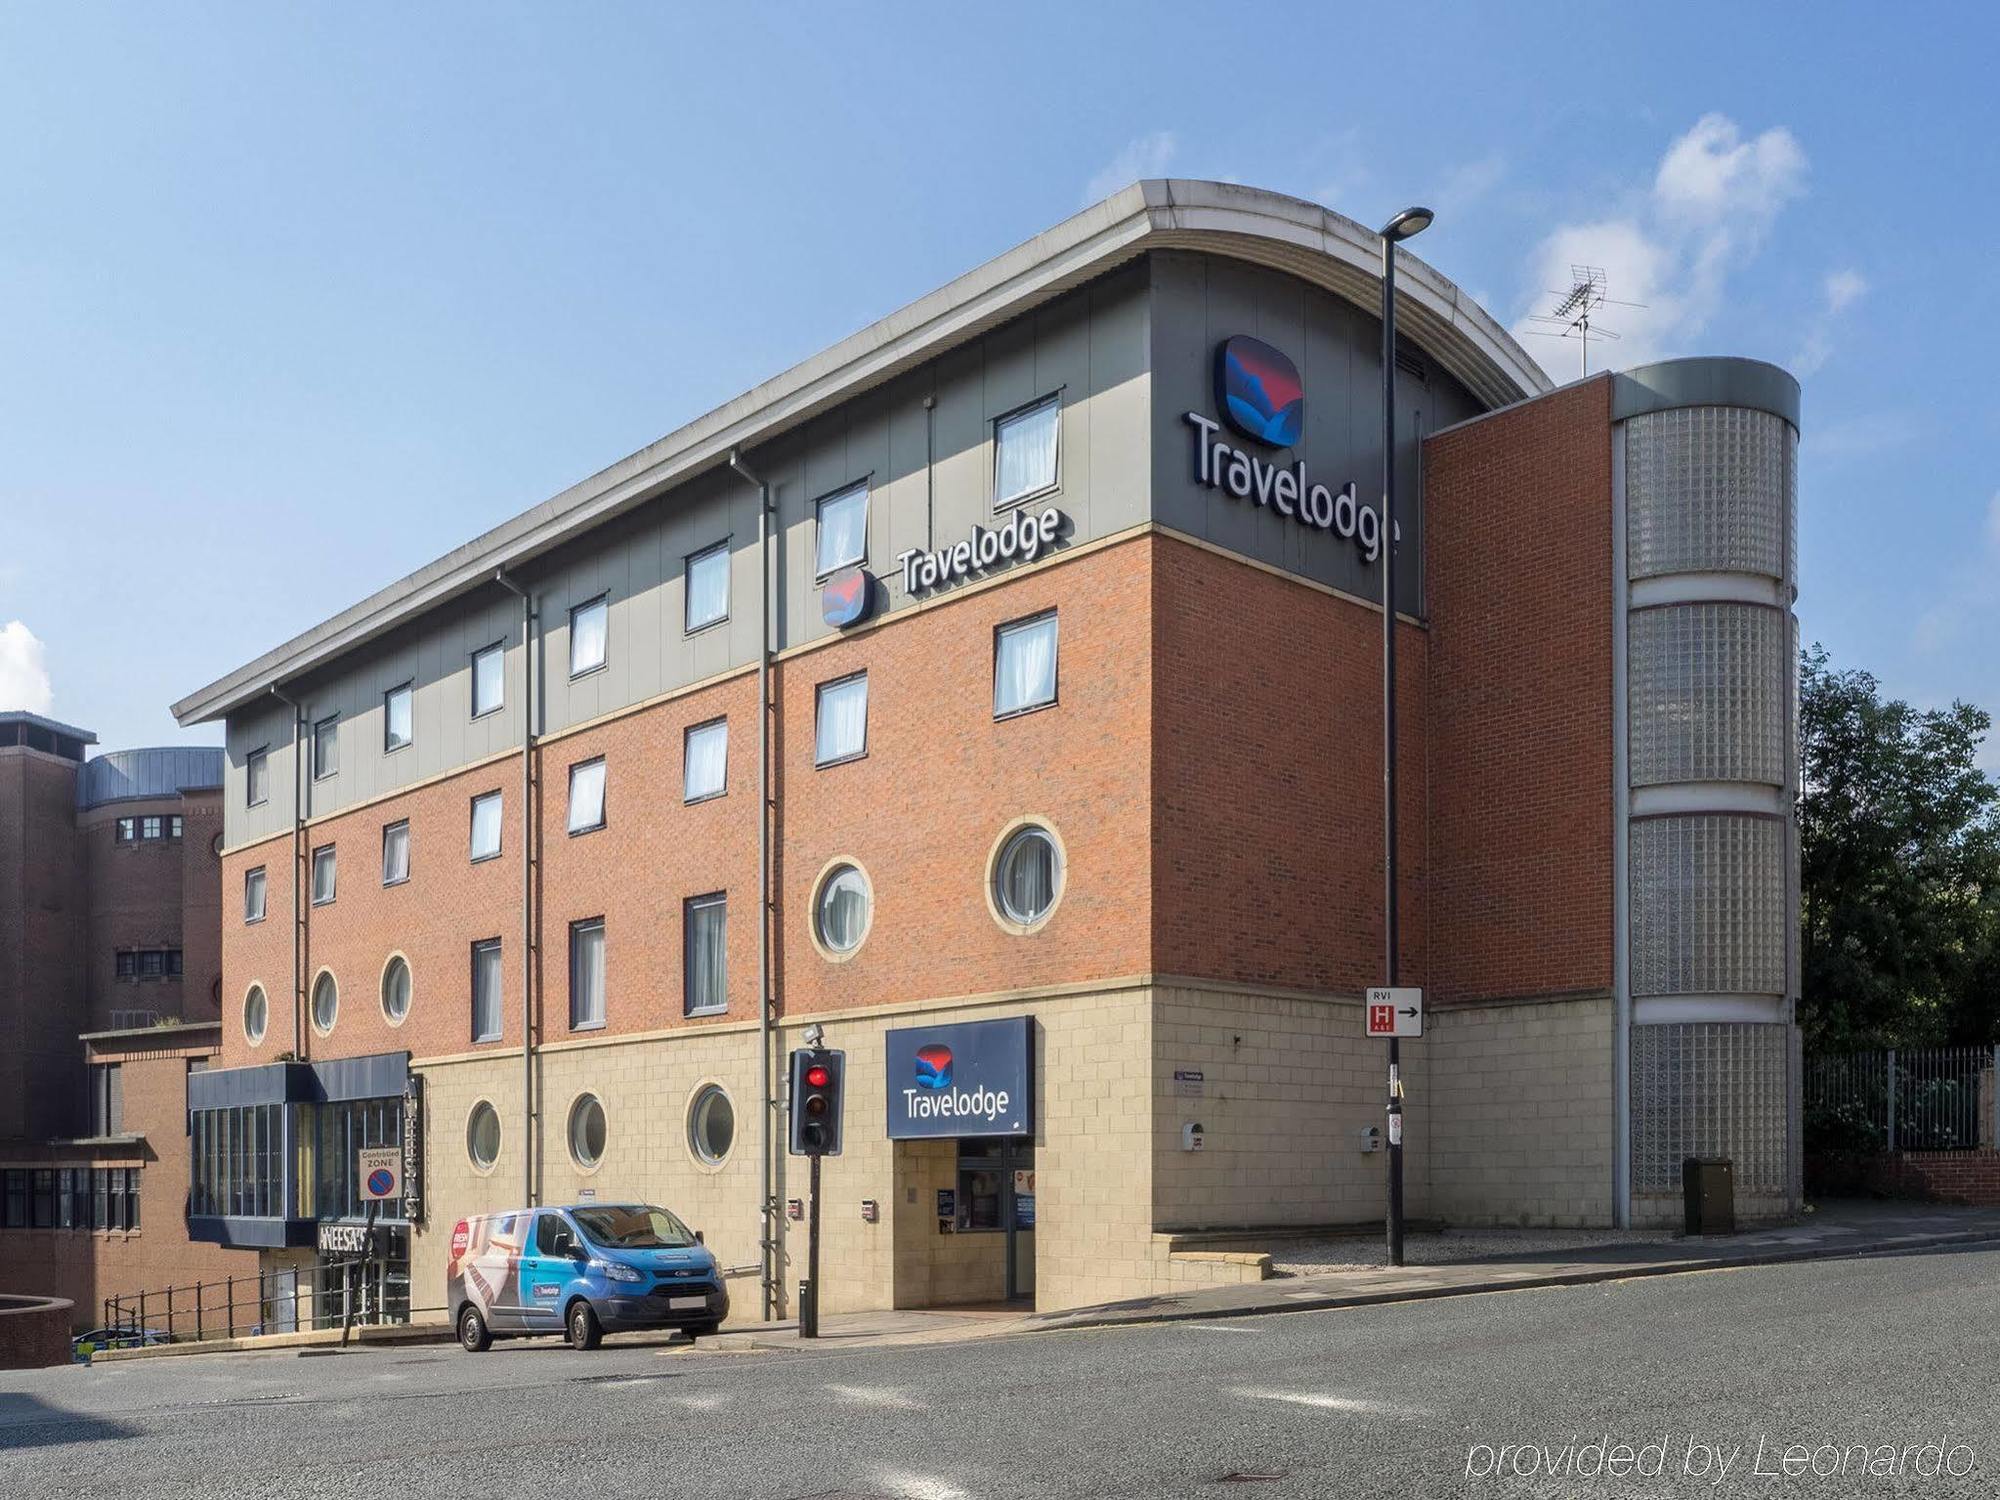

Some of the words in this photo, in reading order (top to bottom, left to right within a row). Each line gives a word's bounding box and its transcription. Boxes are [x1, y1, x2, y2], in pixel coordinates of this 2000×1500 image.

[897, 507, 1060, 593] Travelodge
[1373, 991, 1391, 1000] RVI
[1376, 1006, 1389, 1024] H
[903, 1084, 1010, 1121] Travelodge
[368, 1159, 394, 1167] ZONE
